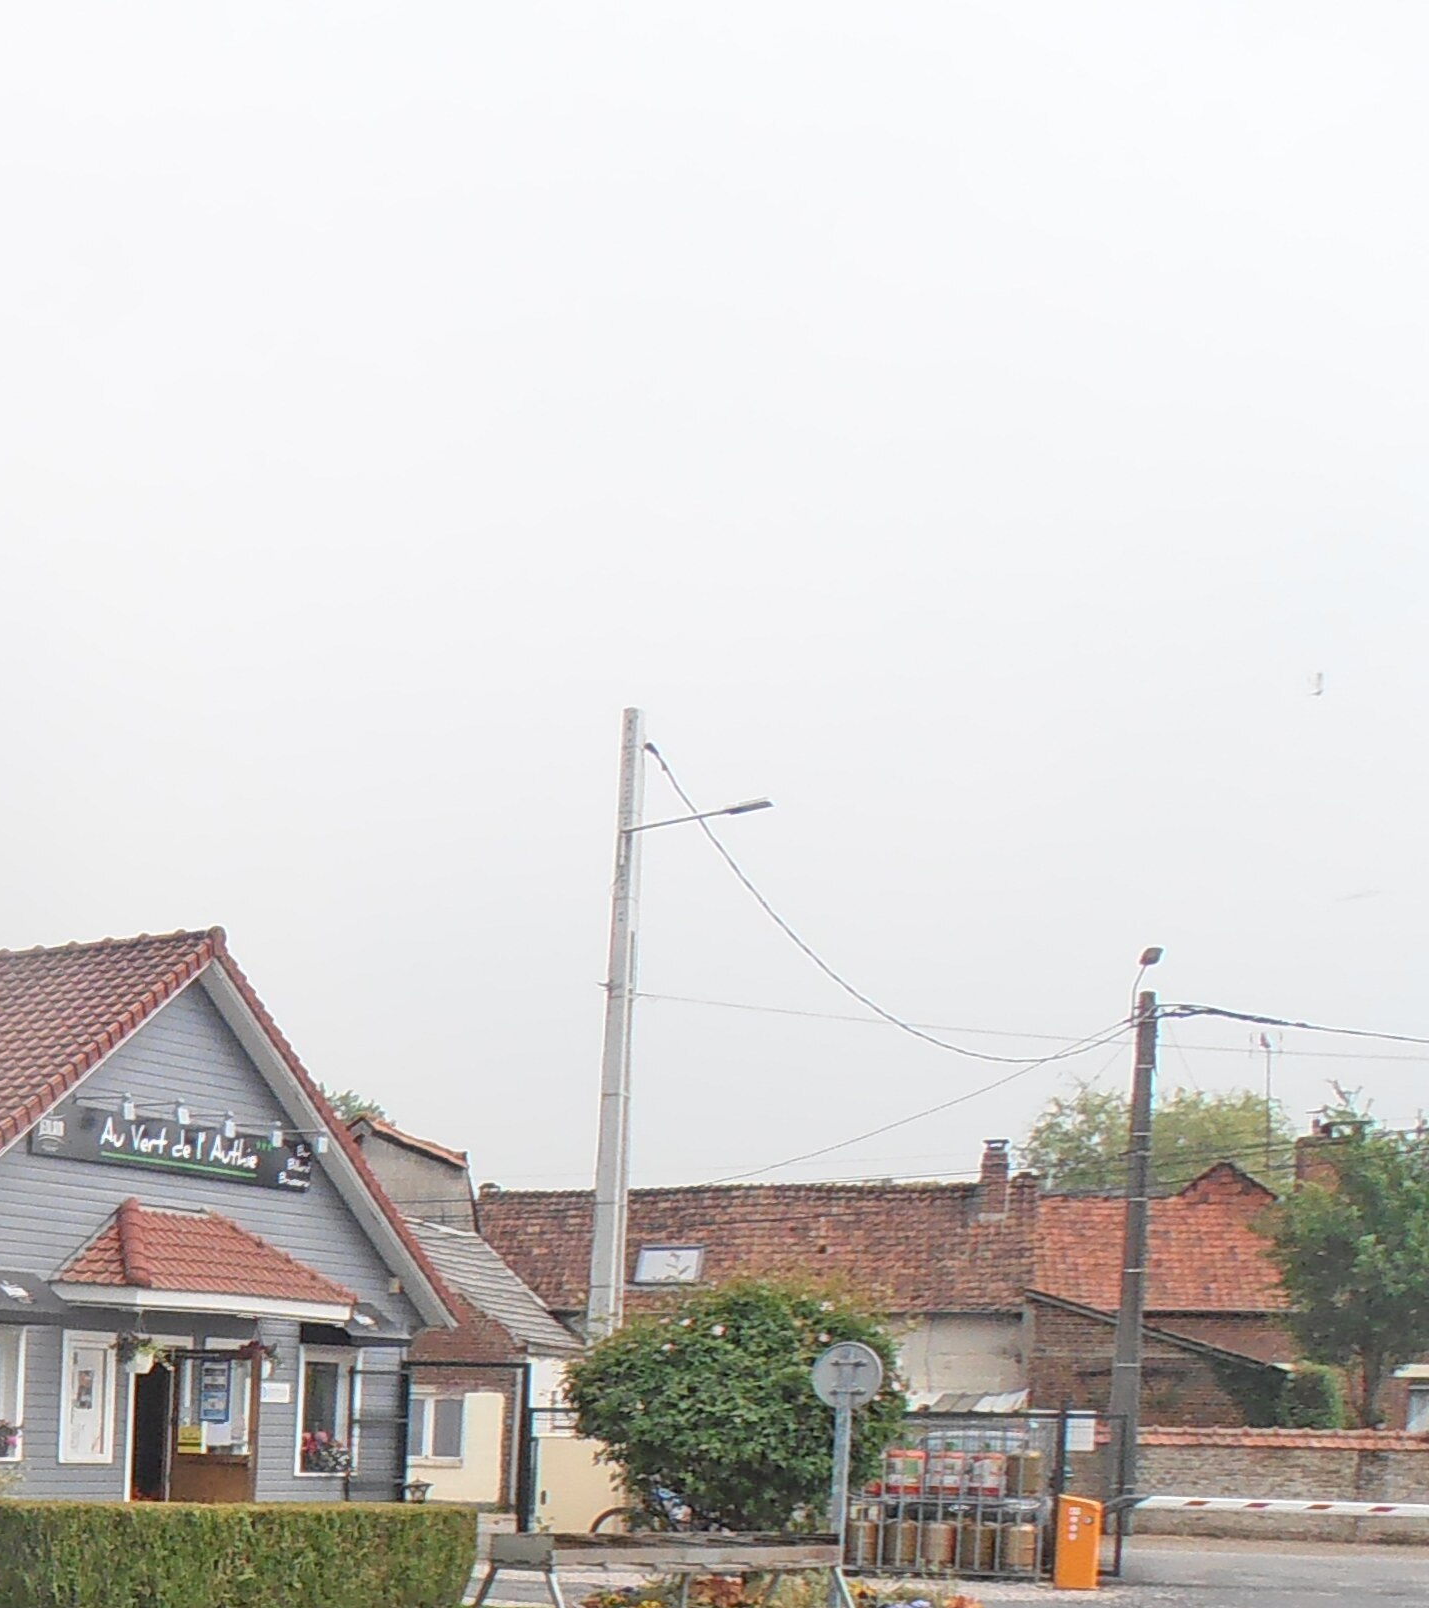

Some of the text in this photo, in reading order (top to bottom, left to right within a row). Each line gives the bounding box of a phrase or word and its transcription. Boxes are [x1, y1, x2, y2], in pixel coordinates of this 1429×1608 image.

[100, 1116, 126, 1147] Au
[130, 1124, 168, 1154] Vert
[171, 1129, 192, 1159] de
